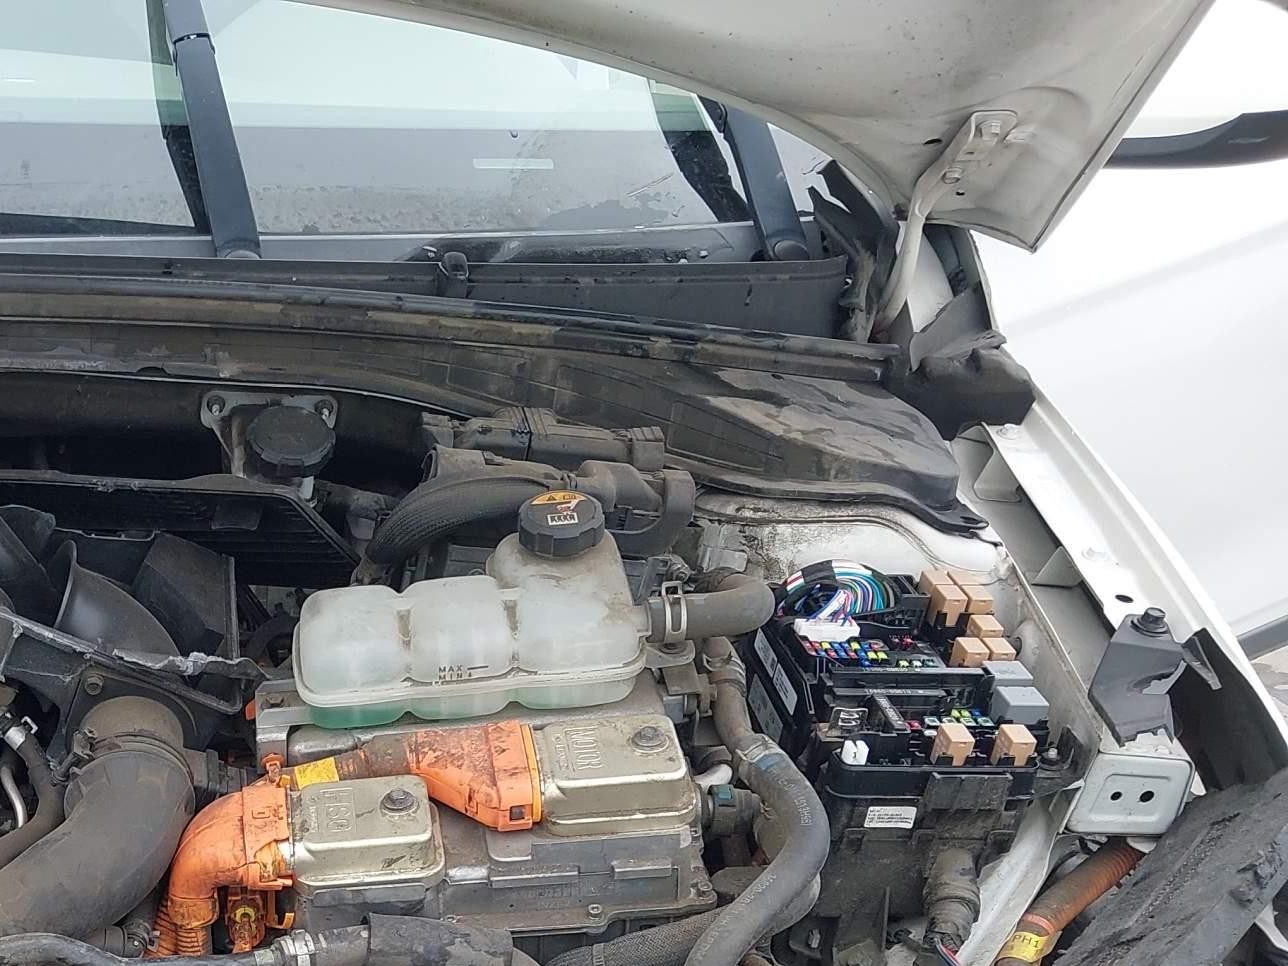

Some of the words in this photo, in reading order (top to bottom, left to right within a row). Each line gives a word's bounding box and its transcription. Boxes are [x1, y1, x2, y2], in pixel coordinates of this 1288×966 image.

[439, 664, 463, 673] MAX
[439, 672, 463, 681] MIN
[570, 730, 602, 770] MOTOR
[1011, 934, 1040, 949] PH1
